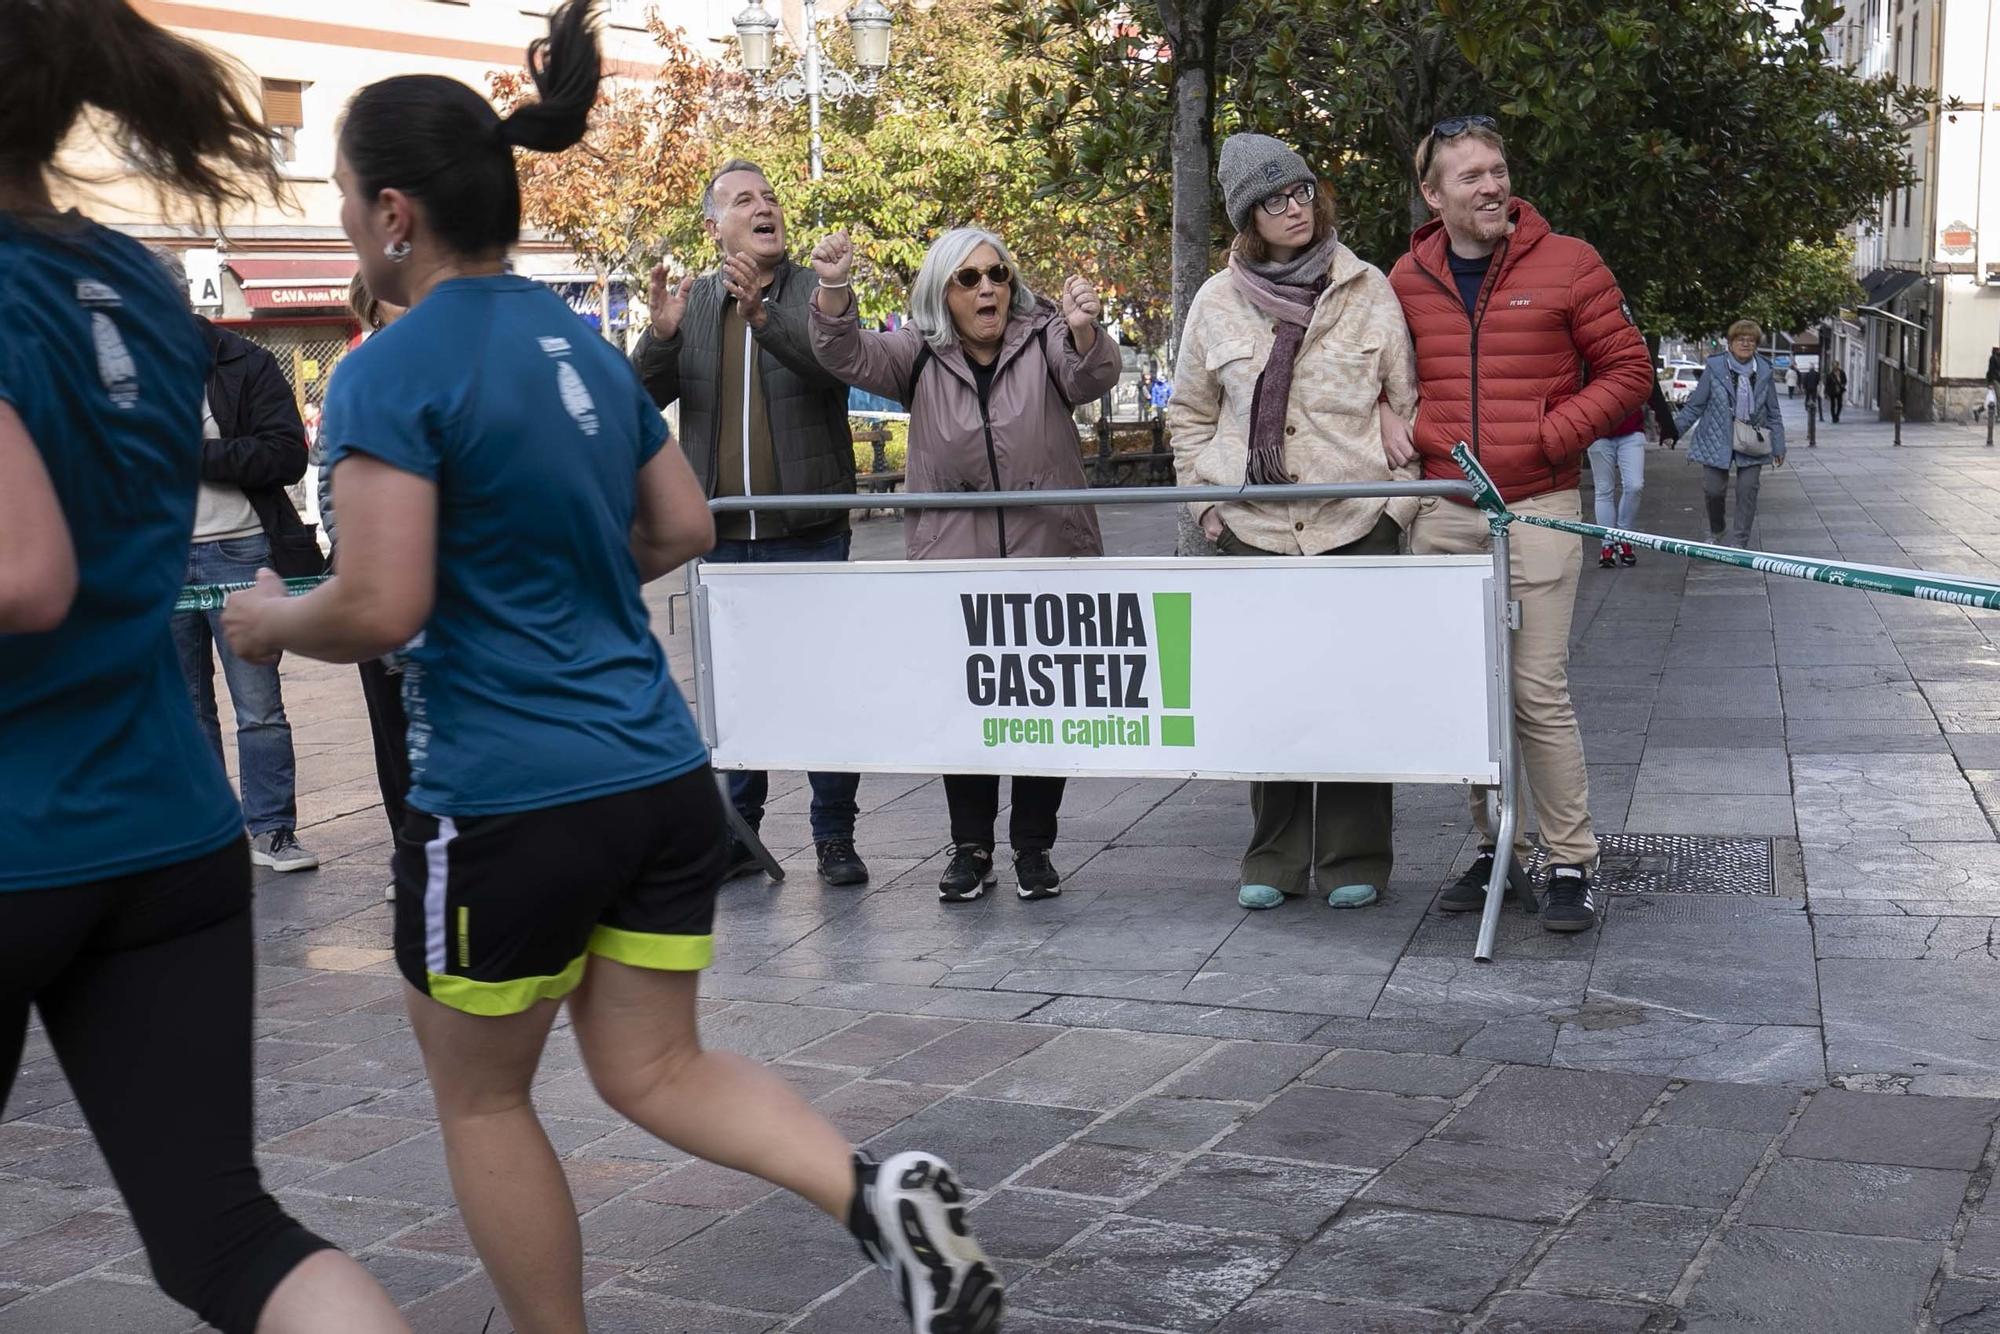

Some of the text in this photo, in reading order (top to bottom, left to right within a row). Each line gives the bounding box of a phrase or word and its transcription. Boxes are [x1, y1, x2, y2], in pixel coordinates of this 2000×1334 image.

[272, 289, 306, 303] CAVA
[307, 292, 330, 302] PARA
[959, 592, 1148, 647] VITORIA
[965, 653, 1149, 708] GASTEIZ
[982, 714, 1151, 748] green capital
